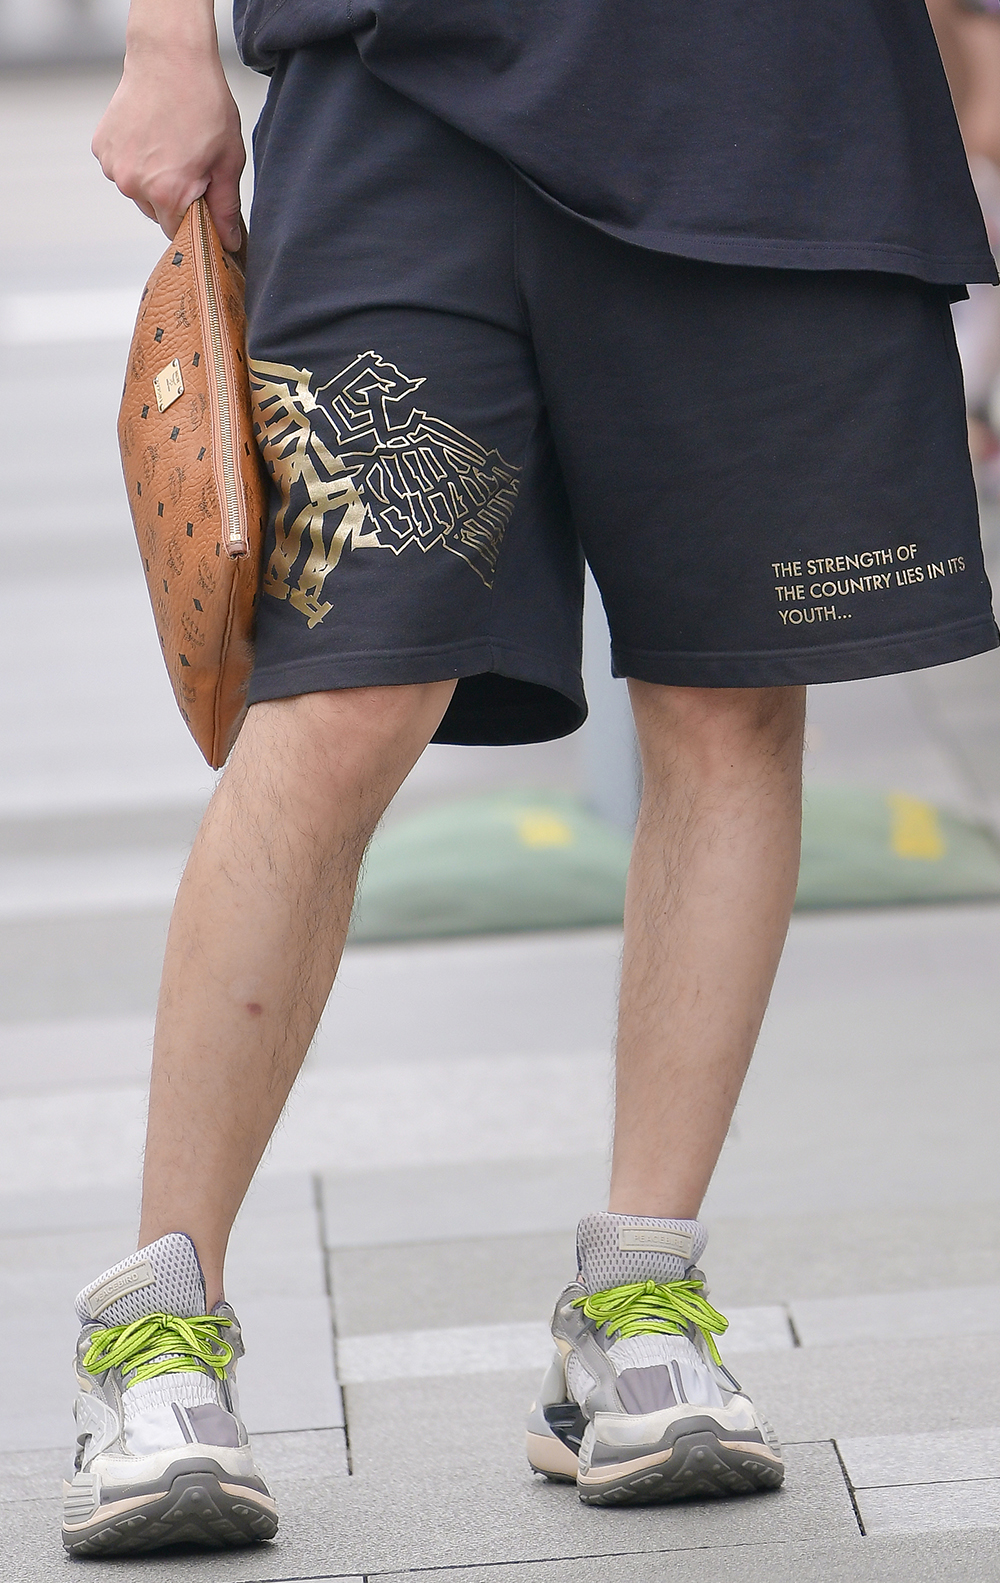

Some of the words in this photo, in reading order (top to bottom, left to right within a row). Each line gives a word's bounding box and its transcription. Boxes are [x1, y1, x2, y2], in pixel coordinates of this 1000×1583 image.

[772, 562, 802, 578] THE
[807, 548, 893, 575] STRENGTH
[896, 543, 917, 561] OF
[775, 585, 806, 602] THE
[810, 572, 892, 599] COUNTRY
[896, 567, 924, 587] LIES
[928, 563, 946, 580] IN
[949, 556, 966, 574] ITS
[779, 605, 852, 626] YOUTH...
[634, 1235, 683, 1248] PEACEBIRD
[95, 1272, 139, 1302] PEACEBIRD
